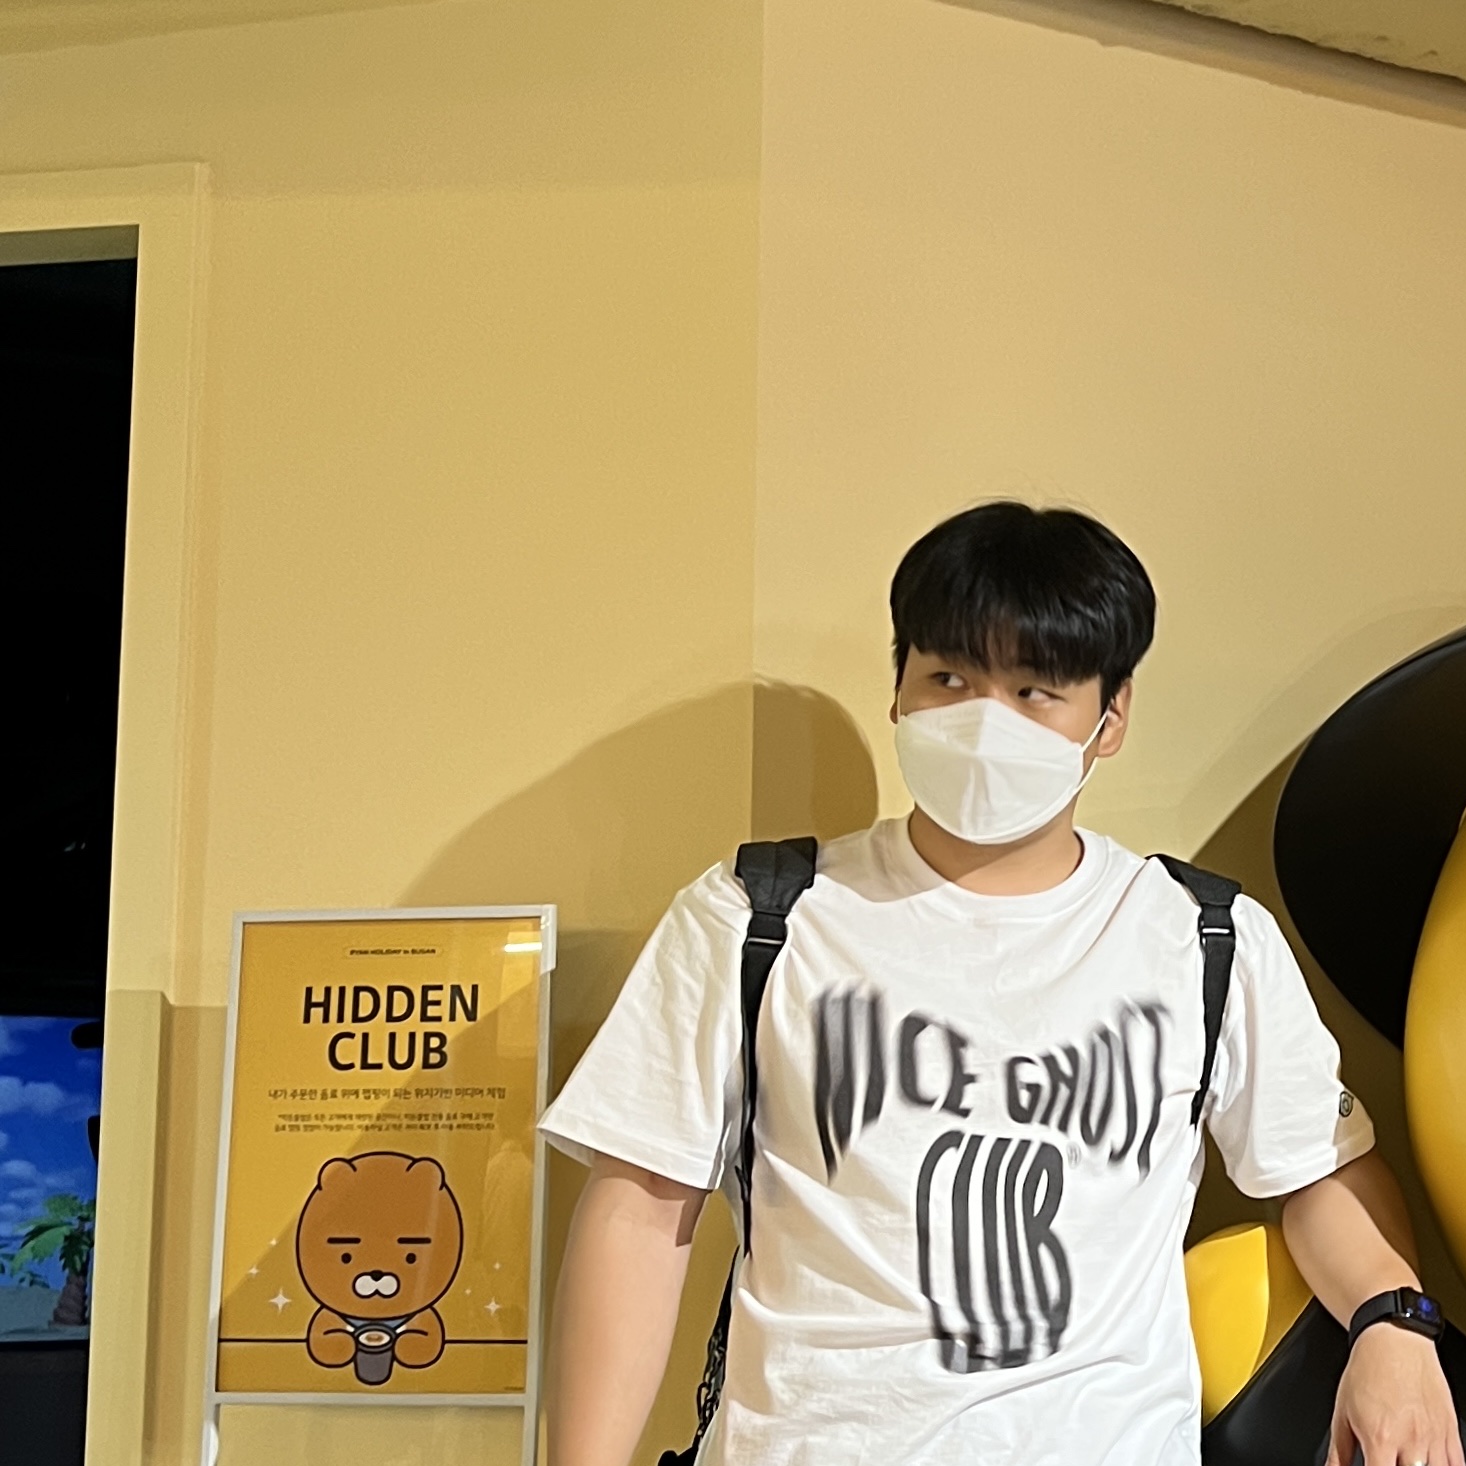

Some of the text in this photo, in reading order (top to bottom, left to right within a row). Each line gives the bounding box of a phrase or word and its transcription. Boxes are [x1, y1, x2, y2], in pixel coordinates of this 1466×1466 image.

[303, 984, 479, 1024] HIDDEN
[328, 1031, 448, 1071] CLUB
[290, 1088, 318, 1100] 주문한
[455, 1088, 484, 1100] 미디어
[916, 1130, 1072, 1374] CLUB
